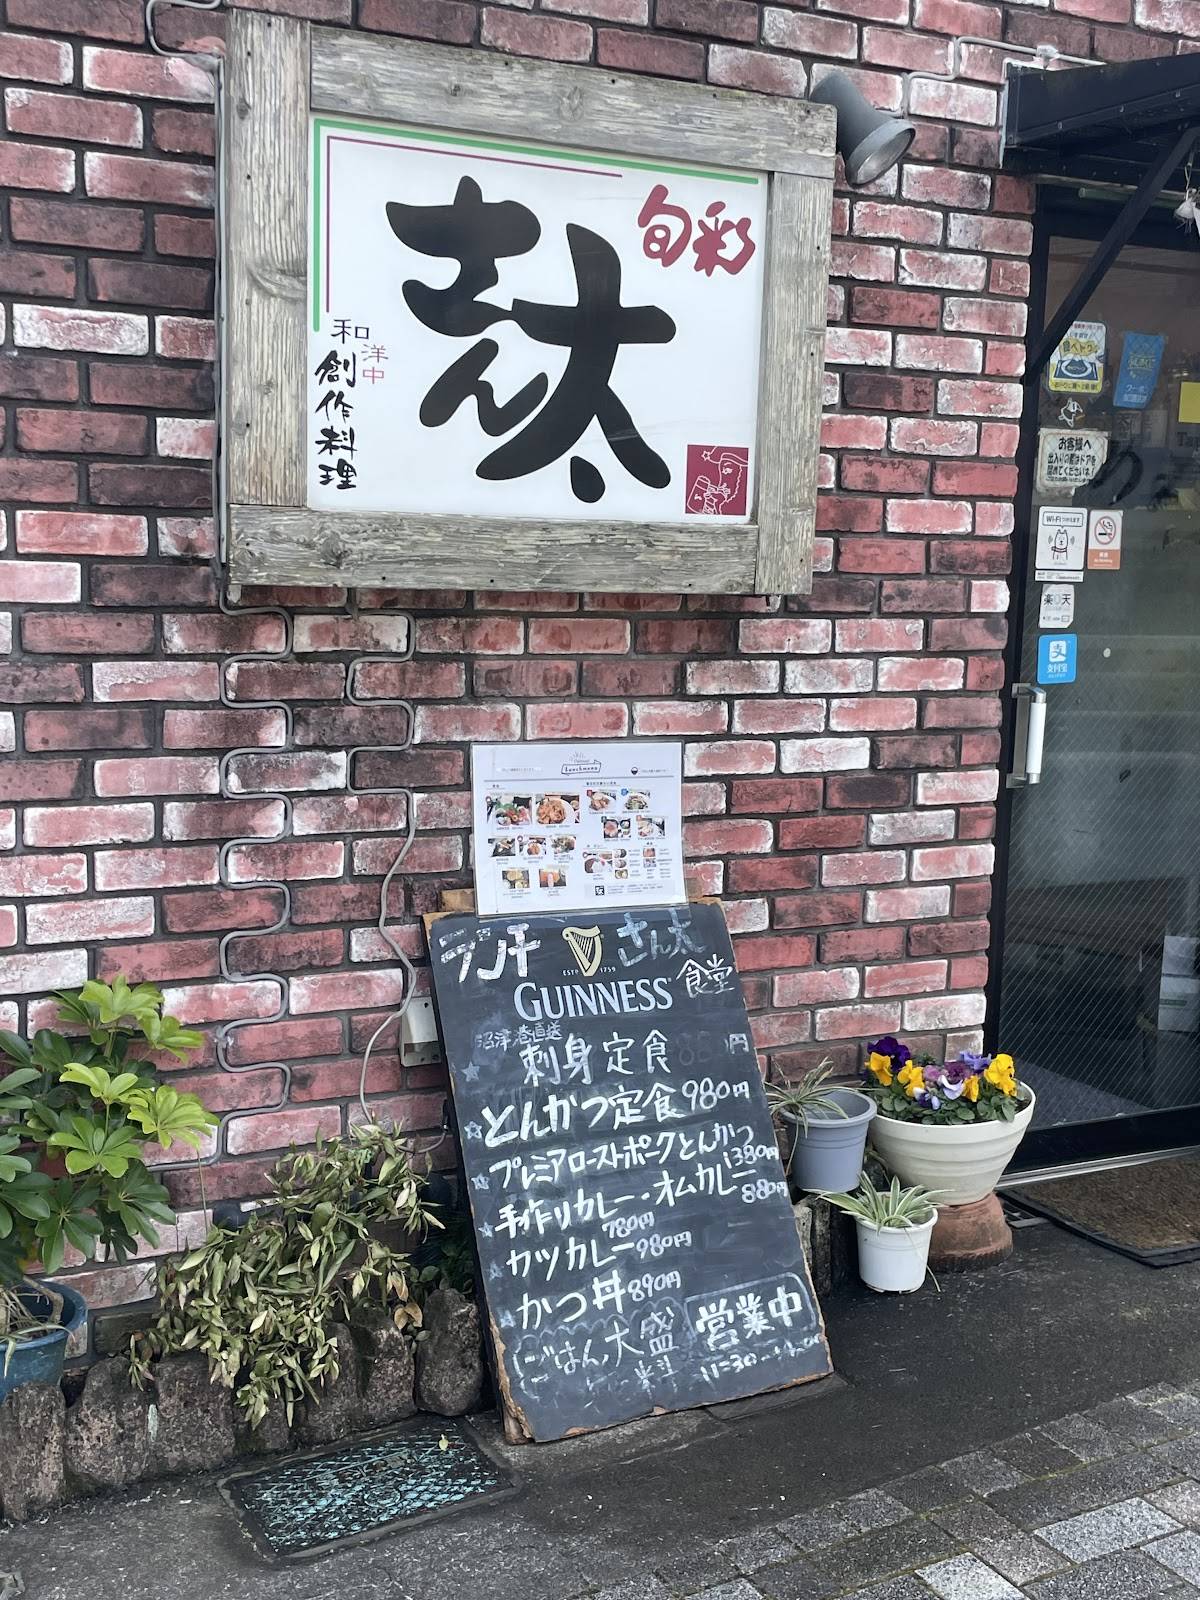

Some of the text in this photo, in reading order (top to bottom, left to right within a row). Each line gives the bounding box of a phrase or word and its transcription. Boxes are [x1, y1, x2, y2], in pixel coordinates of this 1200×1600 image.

[637, 184, 756, 277] 旬彩
[314, 350, 357, 490] 創作料理
[1058, 437, 1092, 451] お客様へ
[438, 922, 542, 984] ランチ
[676, 953, 735, 999] 食堂
[513, 977, 673, 1021] GUINNESS
[481, 1077, 751, 1148] とんかつ定食 980円
[741, 1178, 788, 1203] 880円
[602, 1211, 656, 1239] 780円
[506, 1230, 693, 1282] カツカレー 980円
[516, 1269, 682, 1330] かつ丼 890円
[696, 1285, 803, 1352] 営業中
